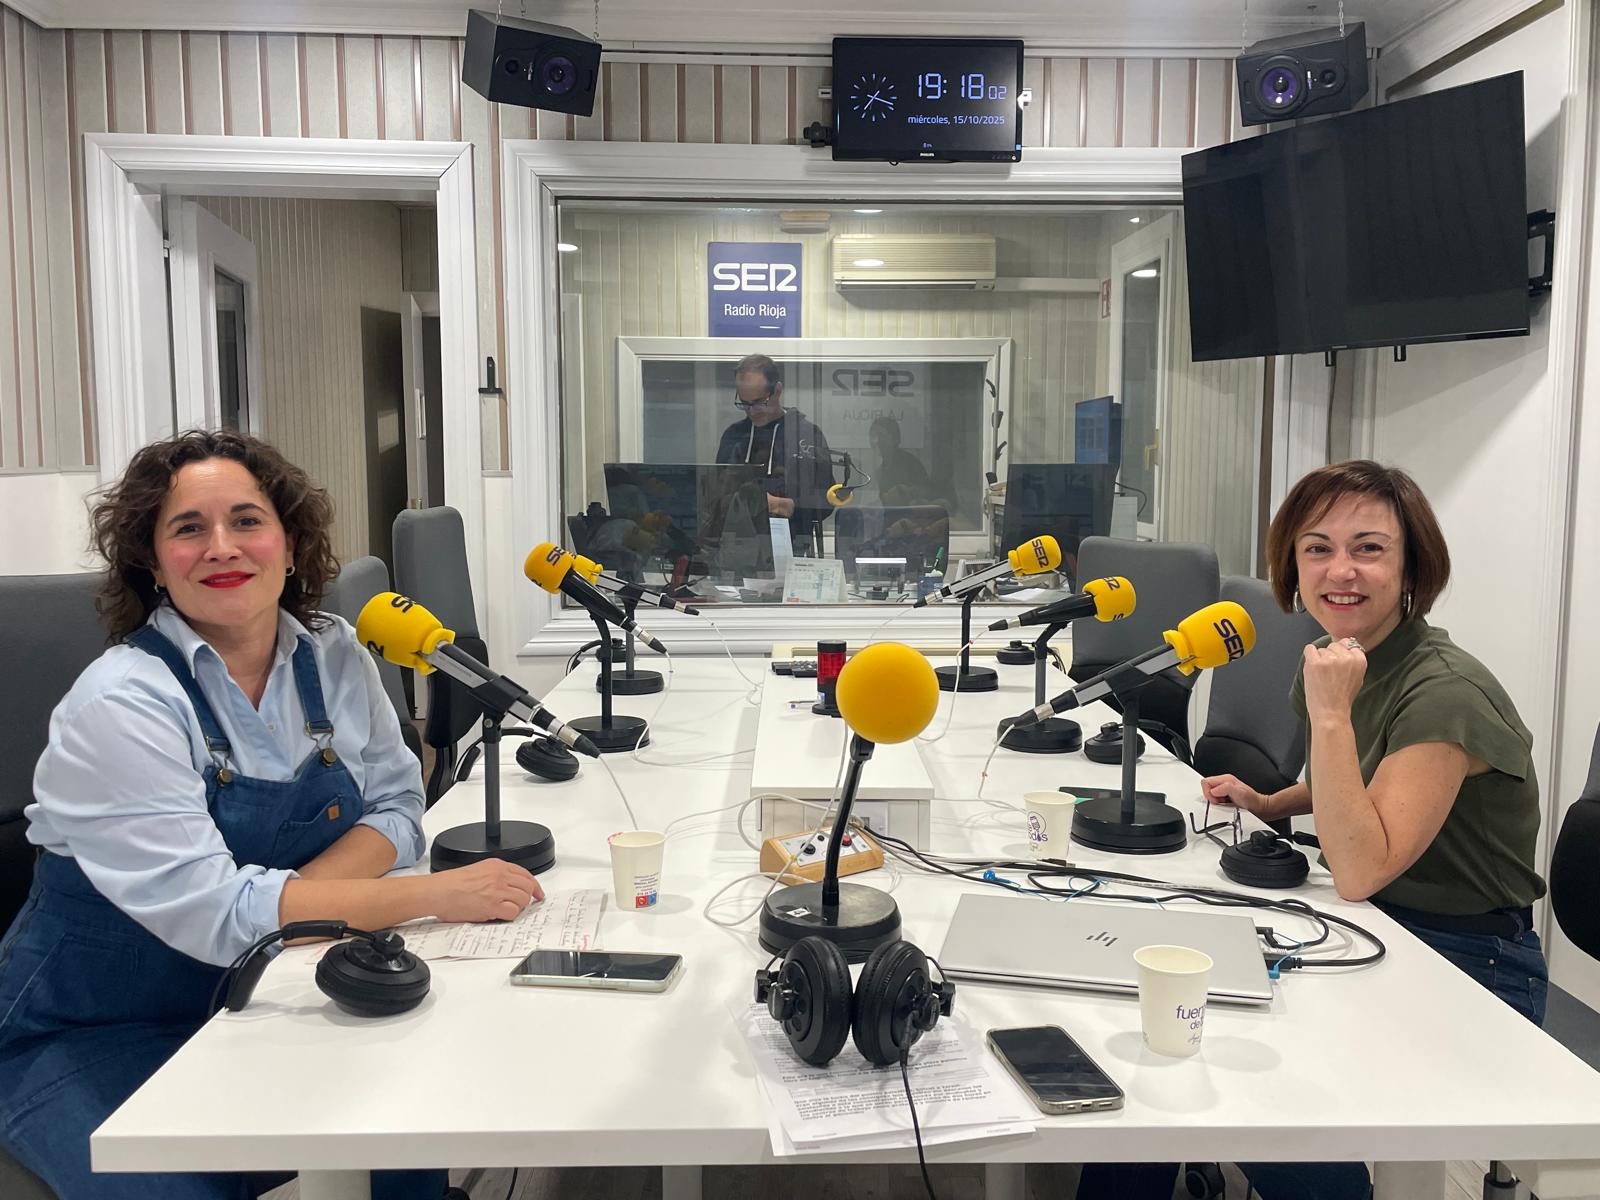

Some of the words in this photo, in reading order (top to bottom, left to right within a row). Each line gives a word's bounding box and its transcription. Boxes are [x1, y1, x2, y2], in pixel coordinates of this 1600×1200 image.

[918, 73, 984, 99] 19:18
[988, 85, 1007, 99] 02
[907, 115, 951, 125] miércoles,
[953, 115, 1005, 125] 15/10/2025
[713, 263, 797, 292] SER
[724, 303, 755, 317] Radio
[759, 303, 786, 319] Rioja
[1031, 538, 1049, 568] SER
[1213, 618, 1245, 662] SER
